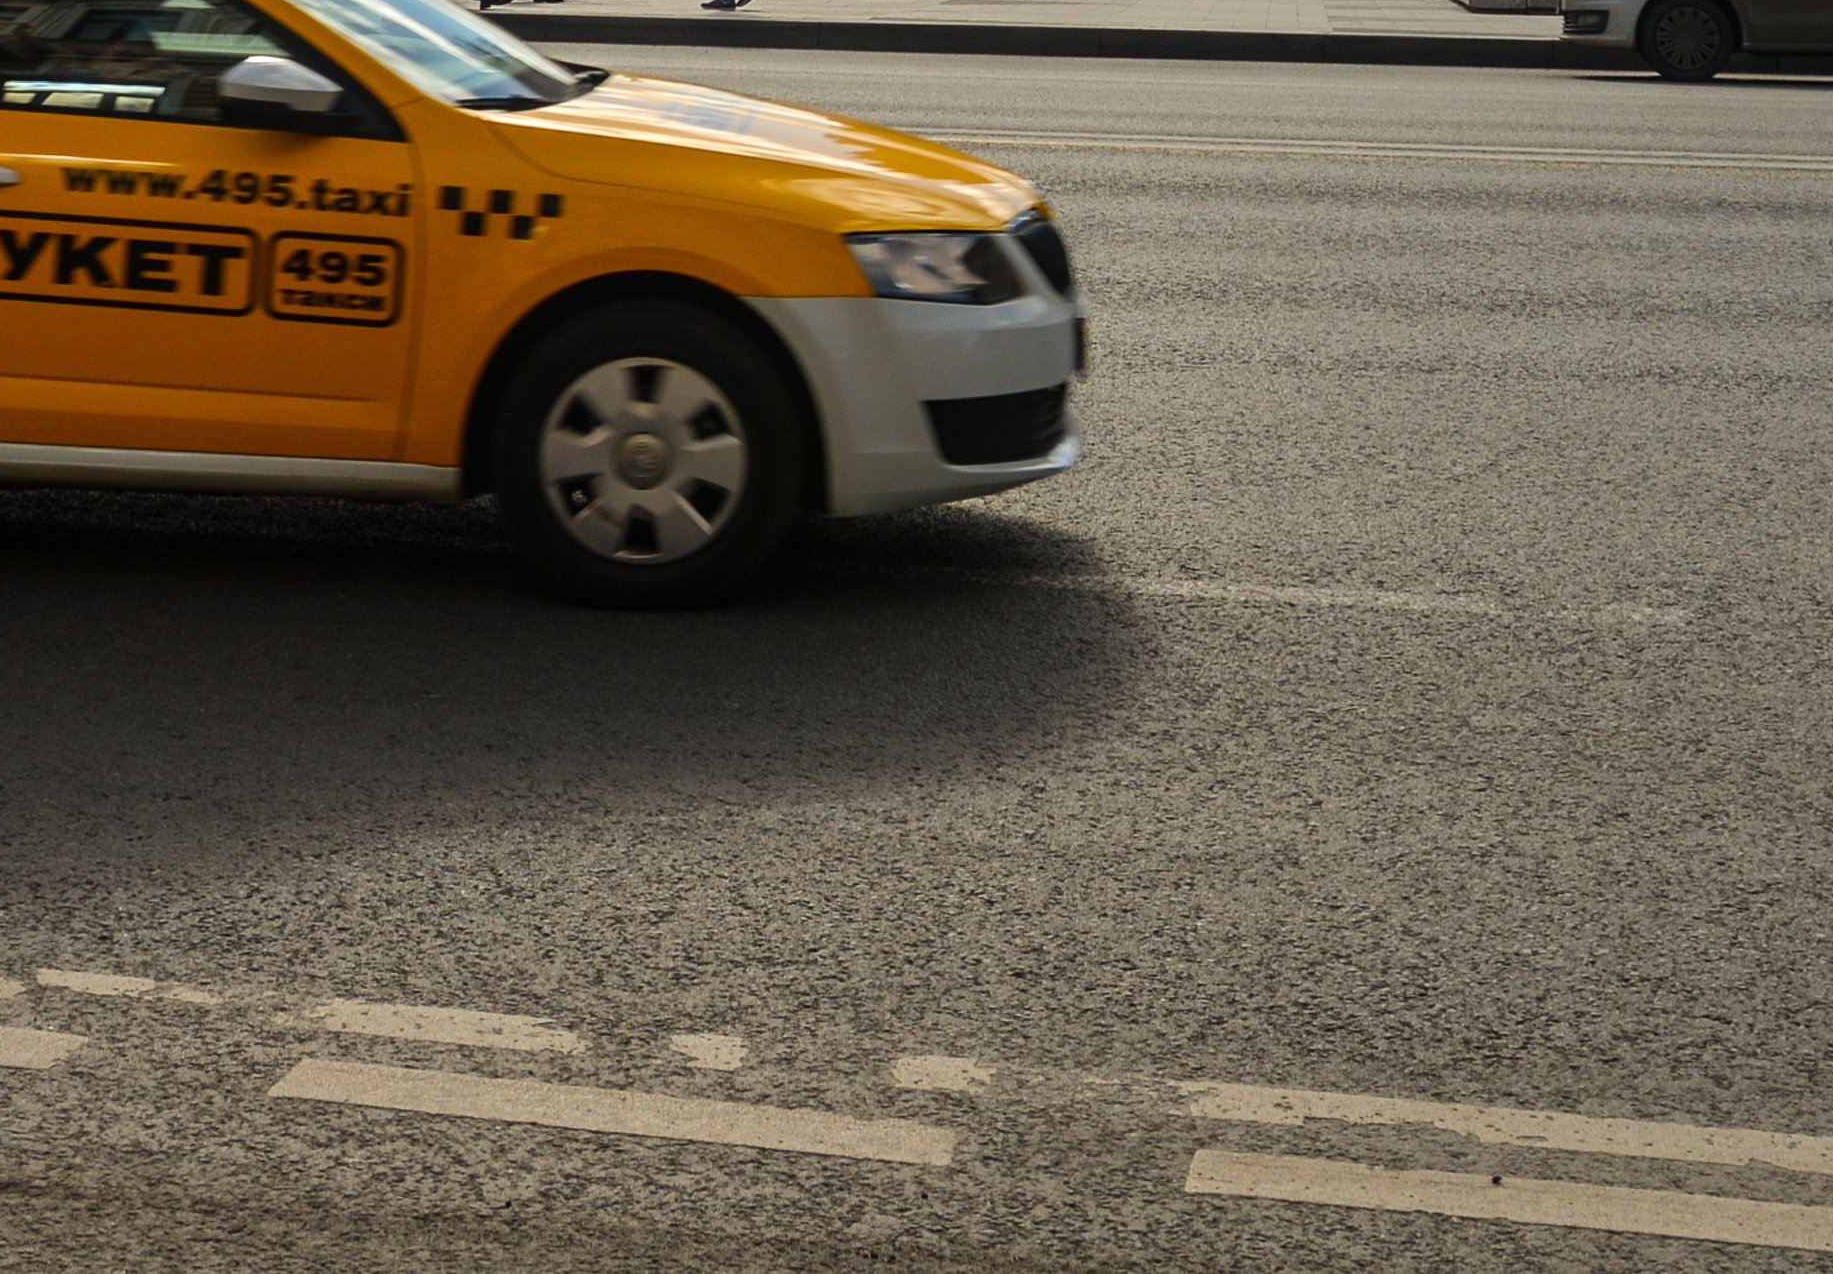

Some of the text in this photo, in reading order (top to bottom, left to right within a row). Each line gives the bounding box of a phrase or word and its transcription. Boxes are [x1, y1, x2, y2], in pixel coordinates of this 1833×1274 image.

[62, 166, 415, 218] www.495.taxi
[279, 248, 389, 288] 495
[278, 286, 387, 314] такси
